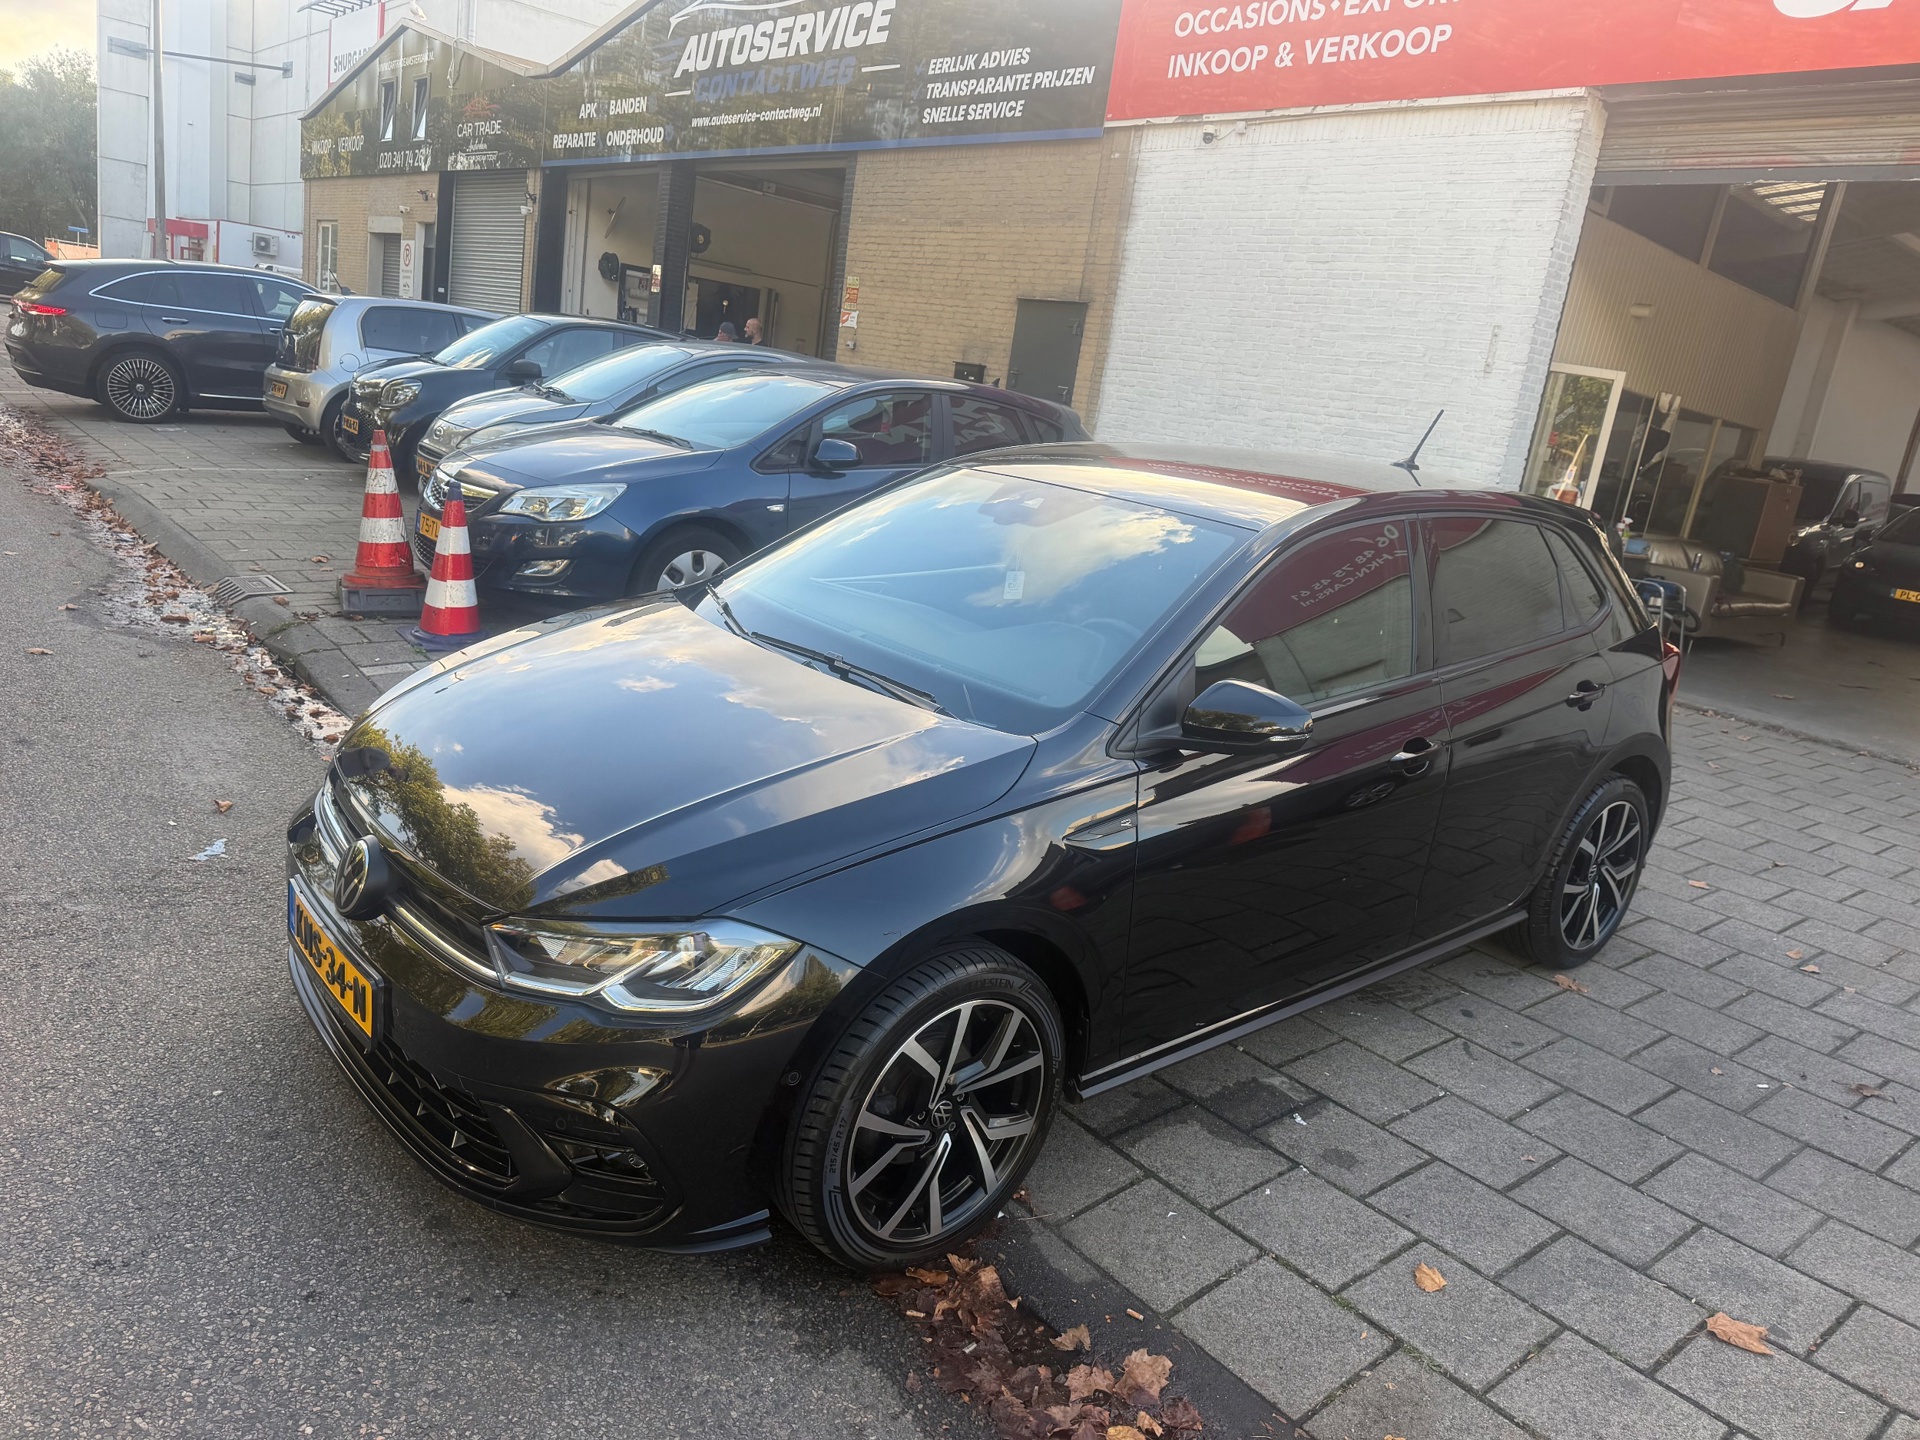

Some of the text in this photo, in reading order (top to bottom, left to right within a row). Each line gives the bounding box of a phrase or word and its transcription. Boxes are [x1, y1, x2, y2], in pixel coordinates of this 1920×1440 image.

[1174, 0, 1326, 37] OCCASIONS
[673, 0, 896, 79] AUTOSERVICE
[1167, 24, 1453, 79] INKOOP & VERKOOP
[333, 46, 373, 74] SHURG
[928, 47, 1031, 75] EERLIJK ADVIES
[693, 56, 857, 101] CONTACTWEG
[926, 65, 1096, 99] TRANSPARANTE PRIJZEN
[579, 96, 648, 119] APK BANDEN
[691, 104, 822, 128] www.autoservice-contactweg.nl
[922, 99, 1025, 124] SNELLE SERVICE
[457, 120, 502, 138] CAR TRADE
[553, 127, 664, 149] REPARATIE ONDERHOUD
[337, 134, 365, 153] VERKOOP
[380, 151, 392, 169] 020
[954, 978, 1015, 996] REDESTEIN
[829, 1140, 841, 1174] 215/45
